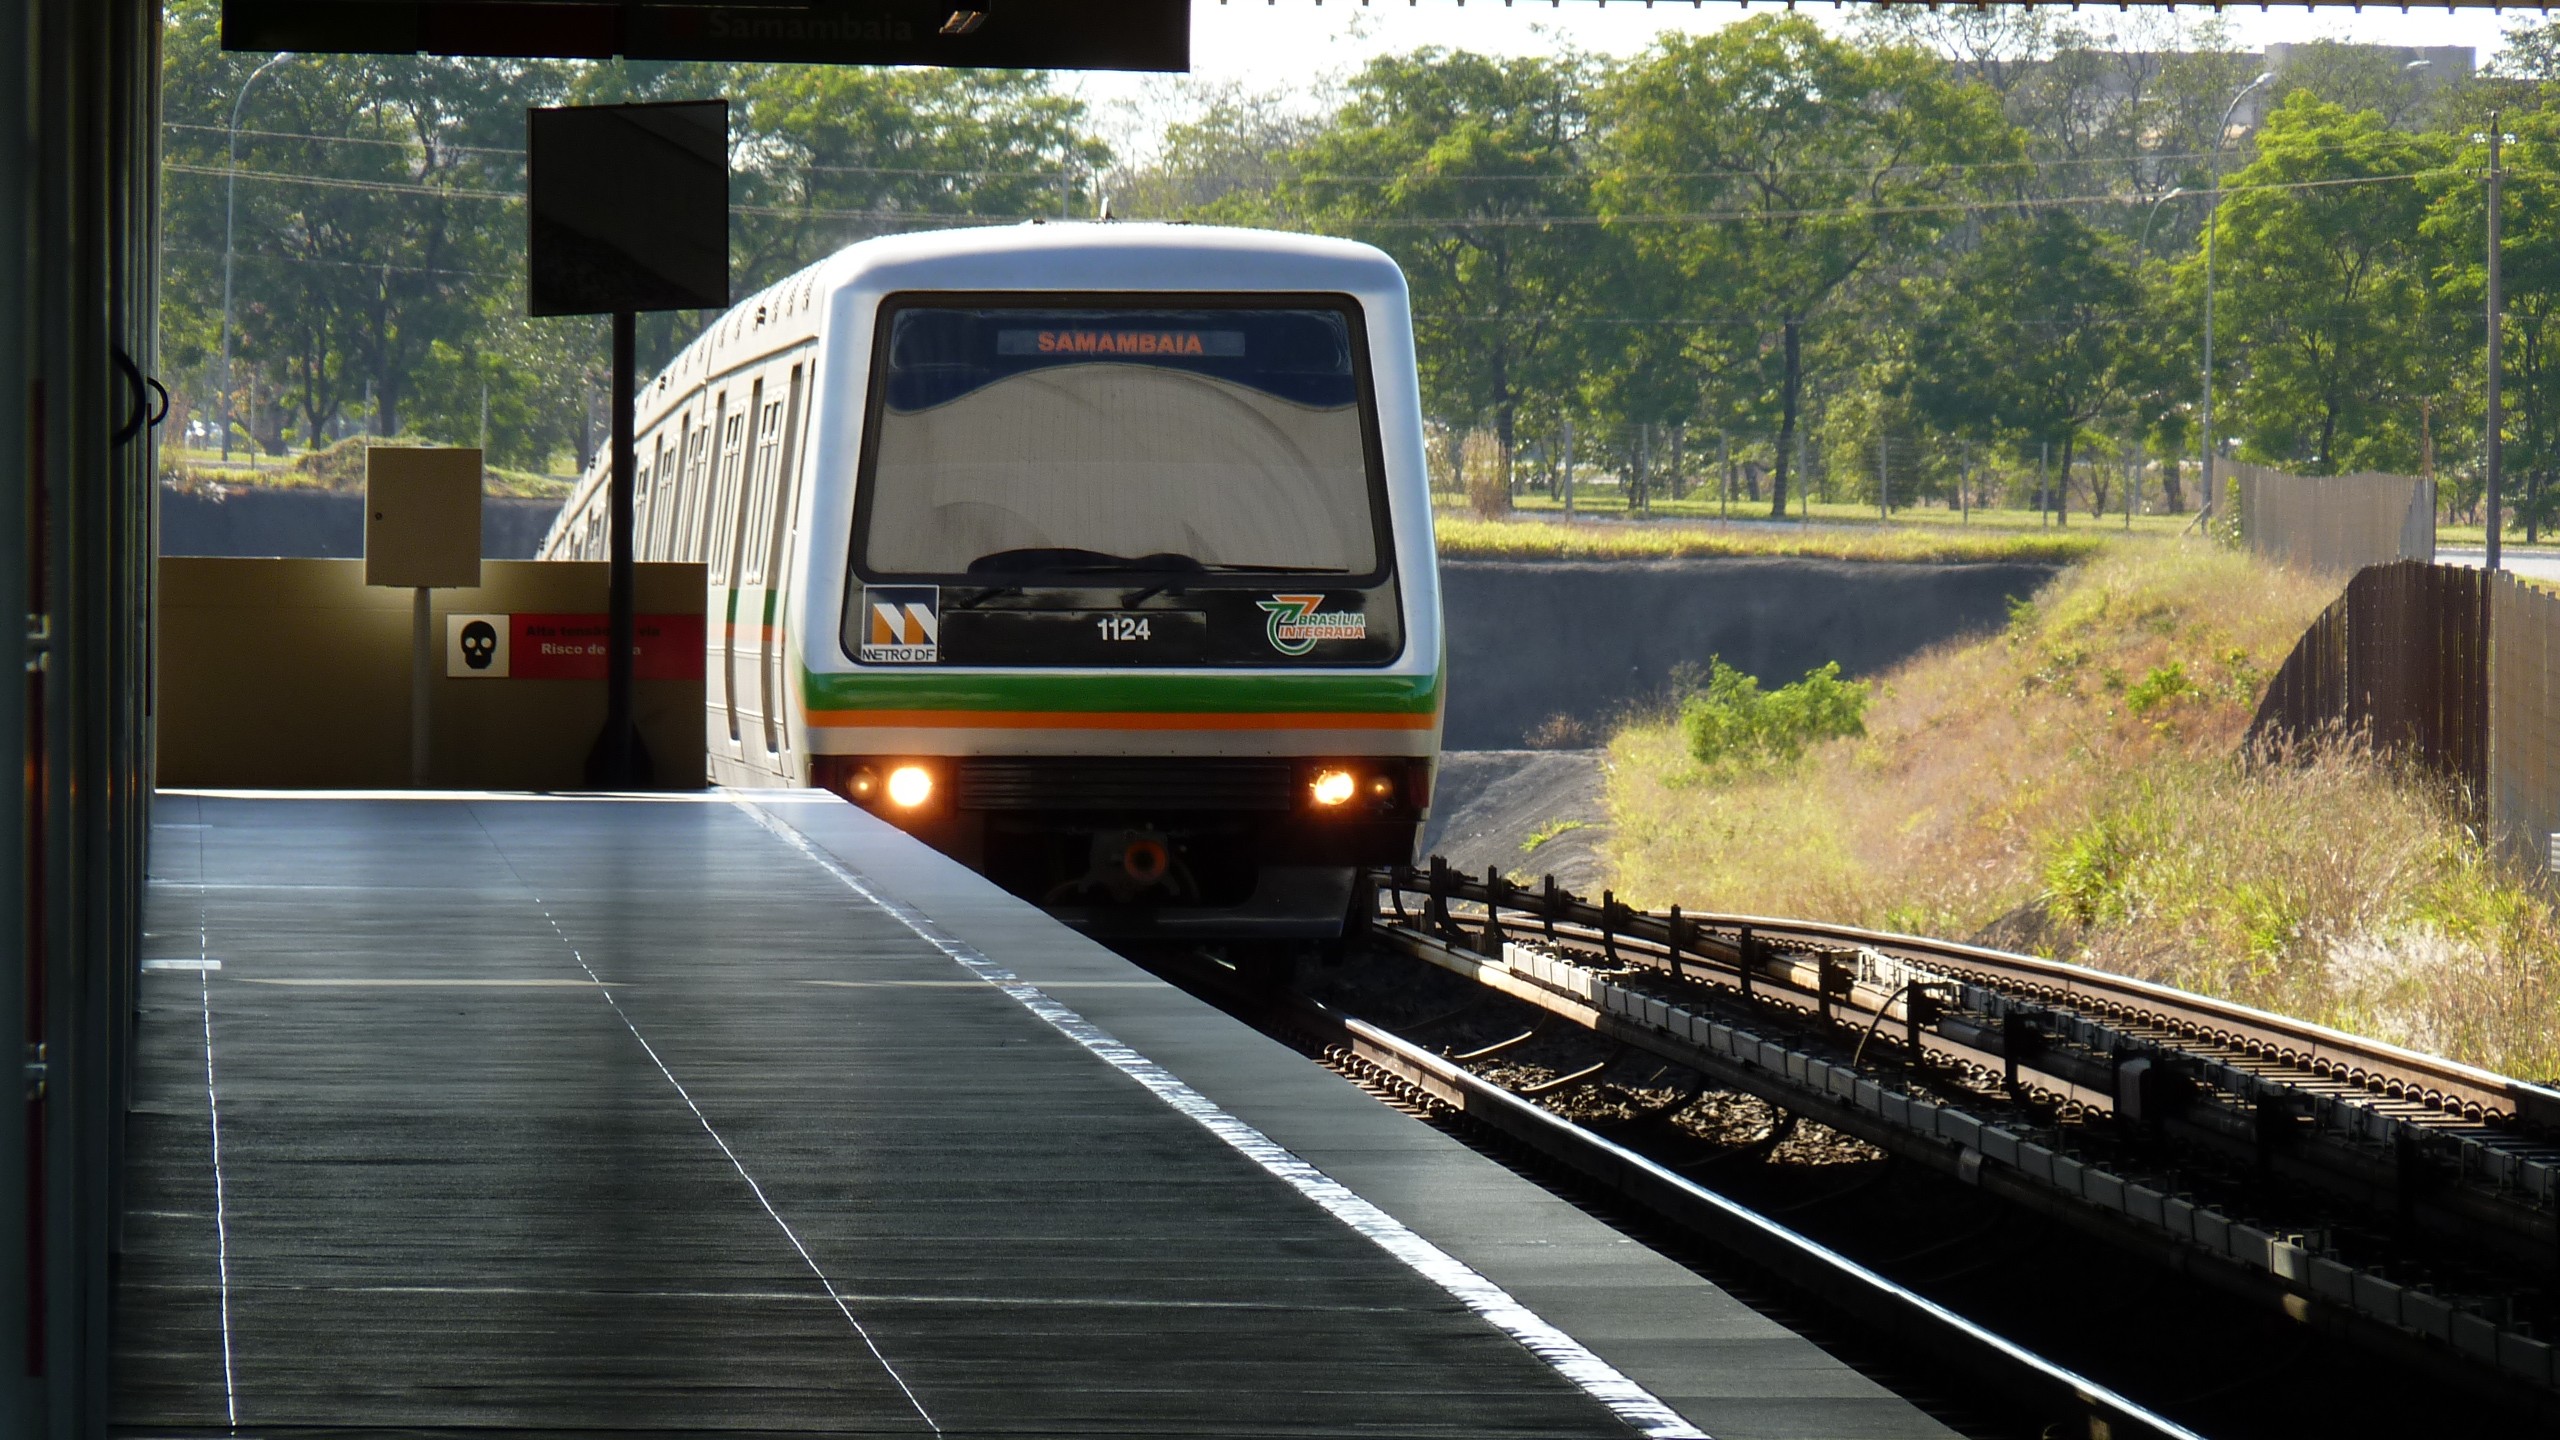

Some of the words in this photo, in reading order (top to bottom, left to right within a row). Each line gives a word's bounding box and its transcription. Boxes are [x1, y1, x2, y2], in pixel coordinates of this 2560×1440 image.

[709, 9, 912, 41] Samambaia
[1038, 331, 1203, 354] SAMAMBAIA
[1297, 610, 1365, 627] BRASÍLIA
[527, 625, 556, 636] Alta
[1097, 618, 1151, 640] 1124
[1279, 625, 1365, 639] INTEGRADA
[541, 643, 583, 655] Risco
[587, 643, 606, 655] de
[914, 649, 936, 661] DF
